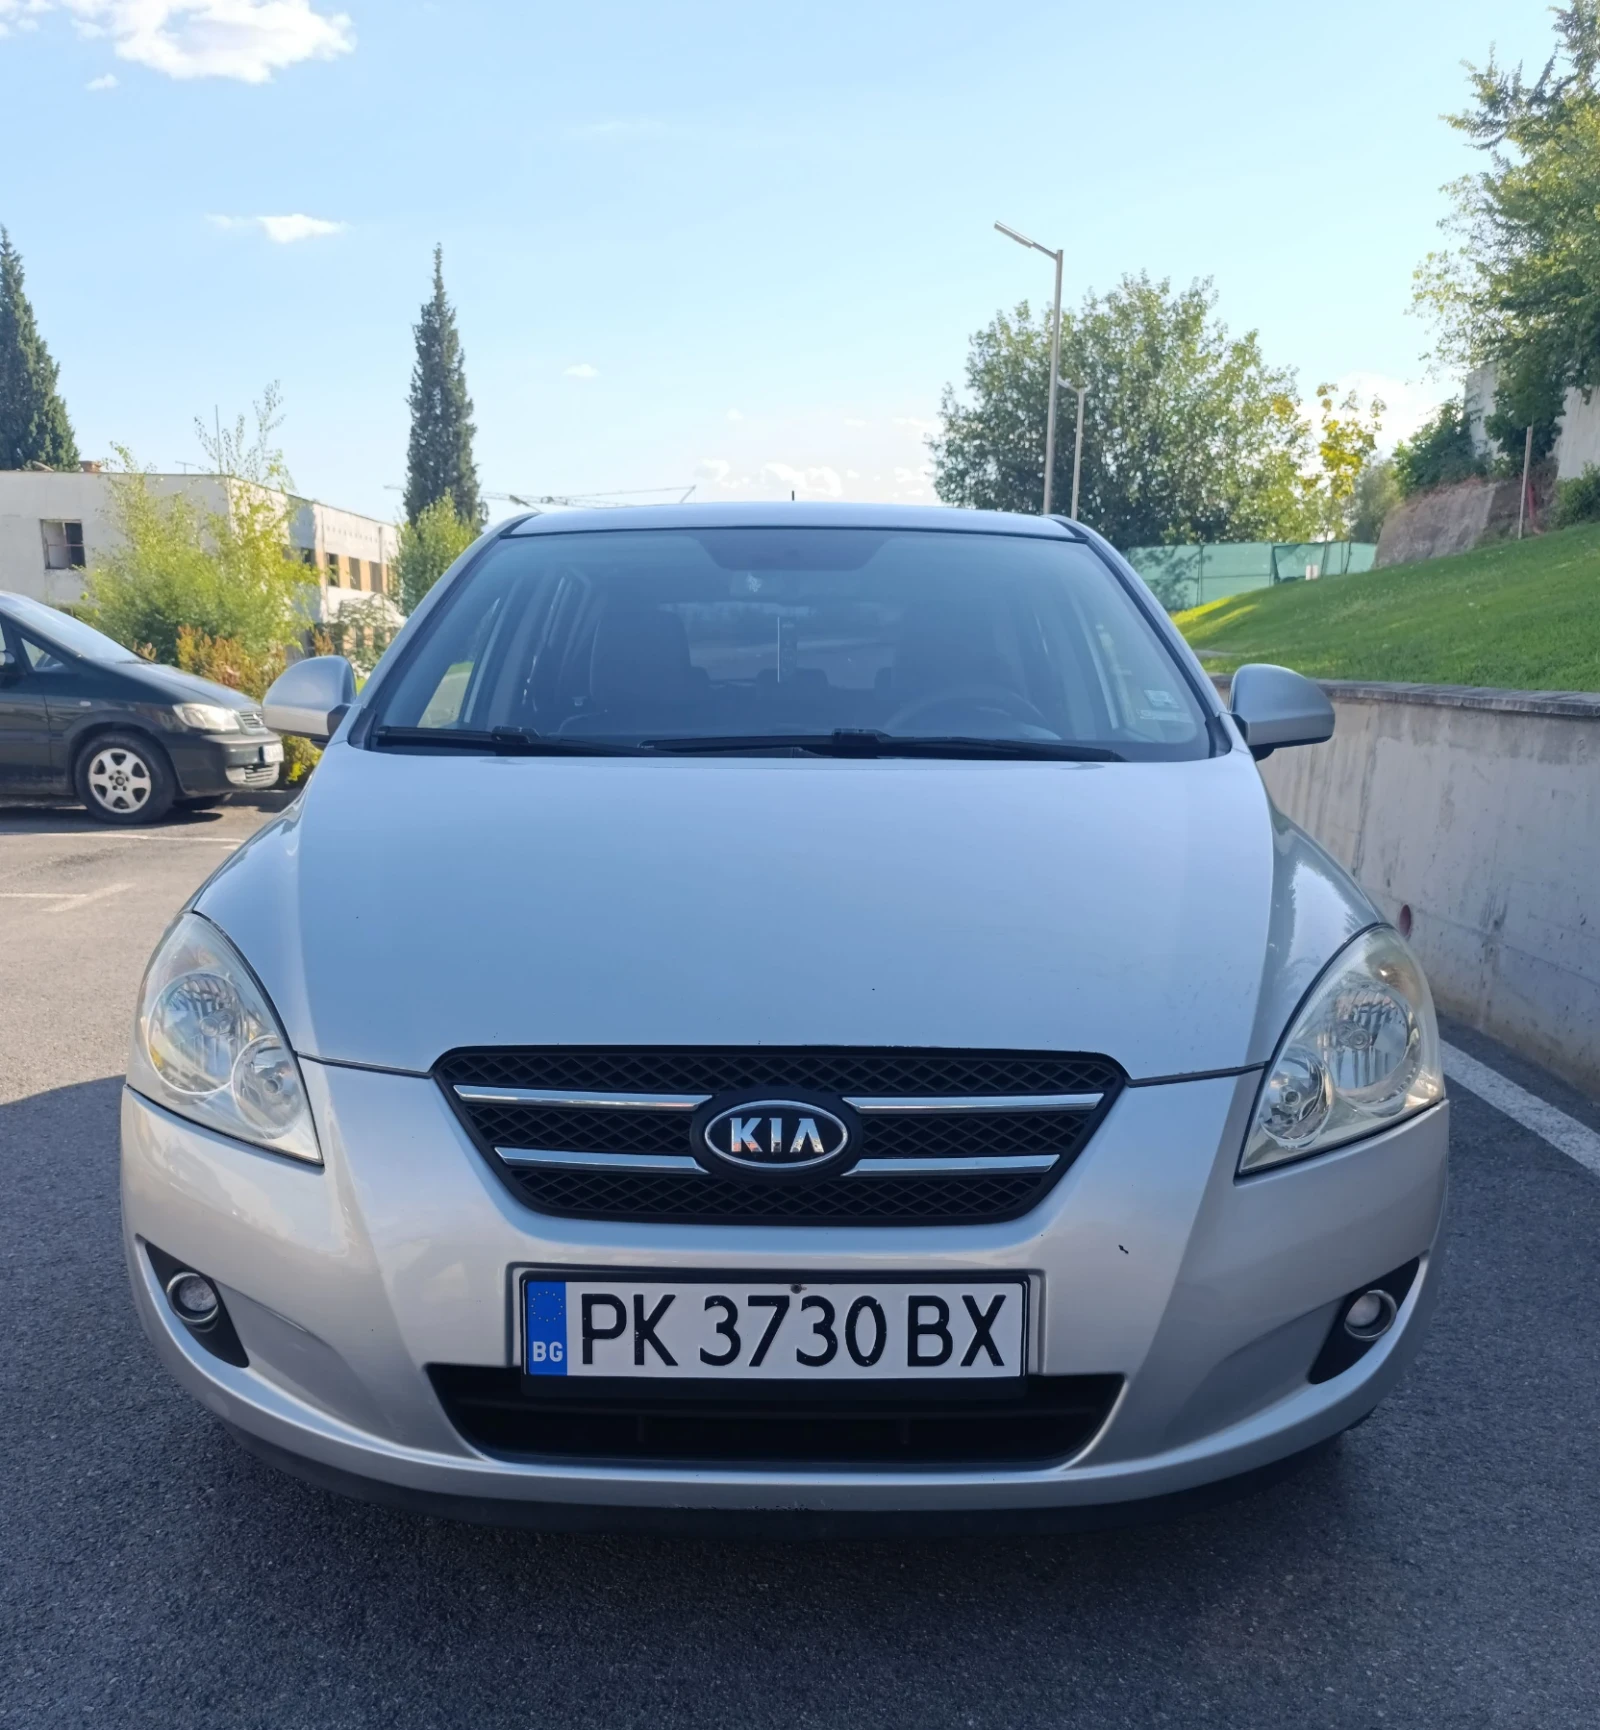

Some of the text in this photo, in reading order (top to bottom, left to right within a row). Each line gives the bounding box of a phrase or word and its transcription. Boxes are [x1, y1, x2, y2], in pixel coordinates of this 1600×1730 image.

[729, 1117, 825, 1153] KIA
[581, 1293, 1007, 1367] PK 3730 BX
[532, 1341, 563, 1362] BG
